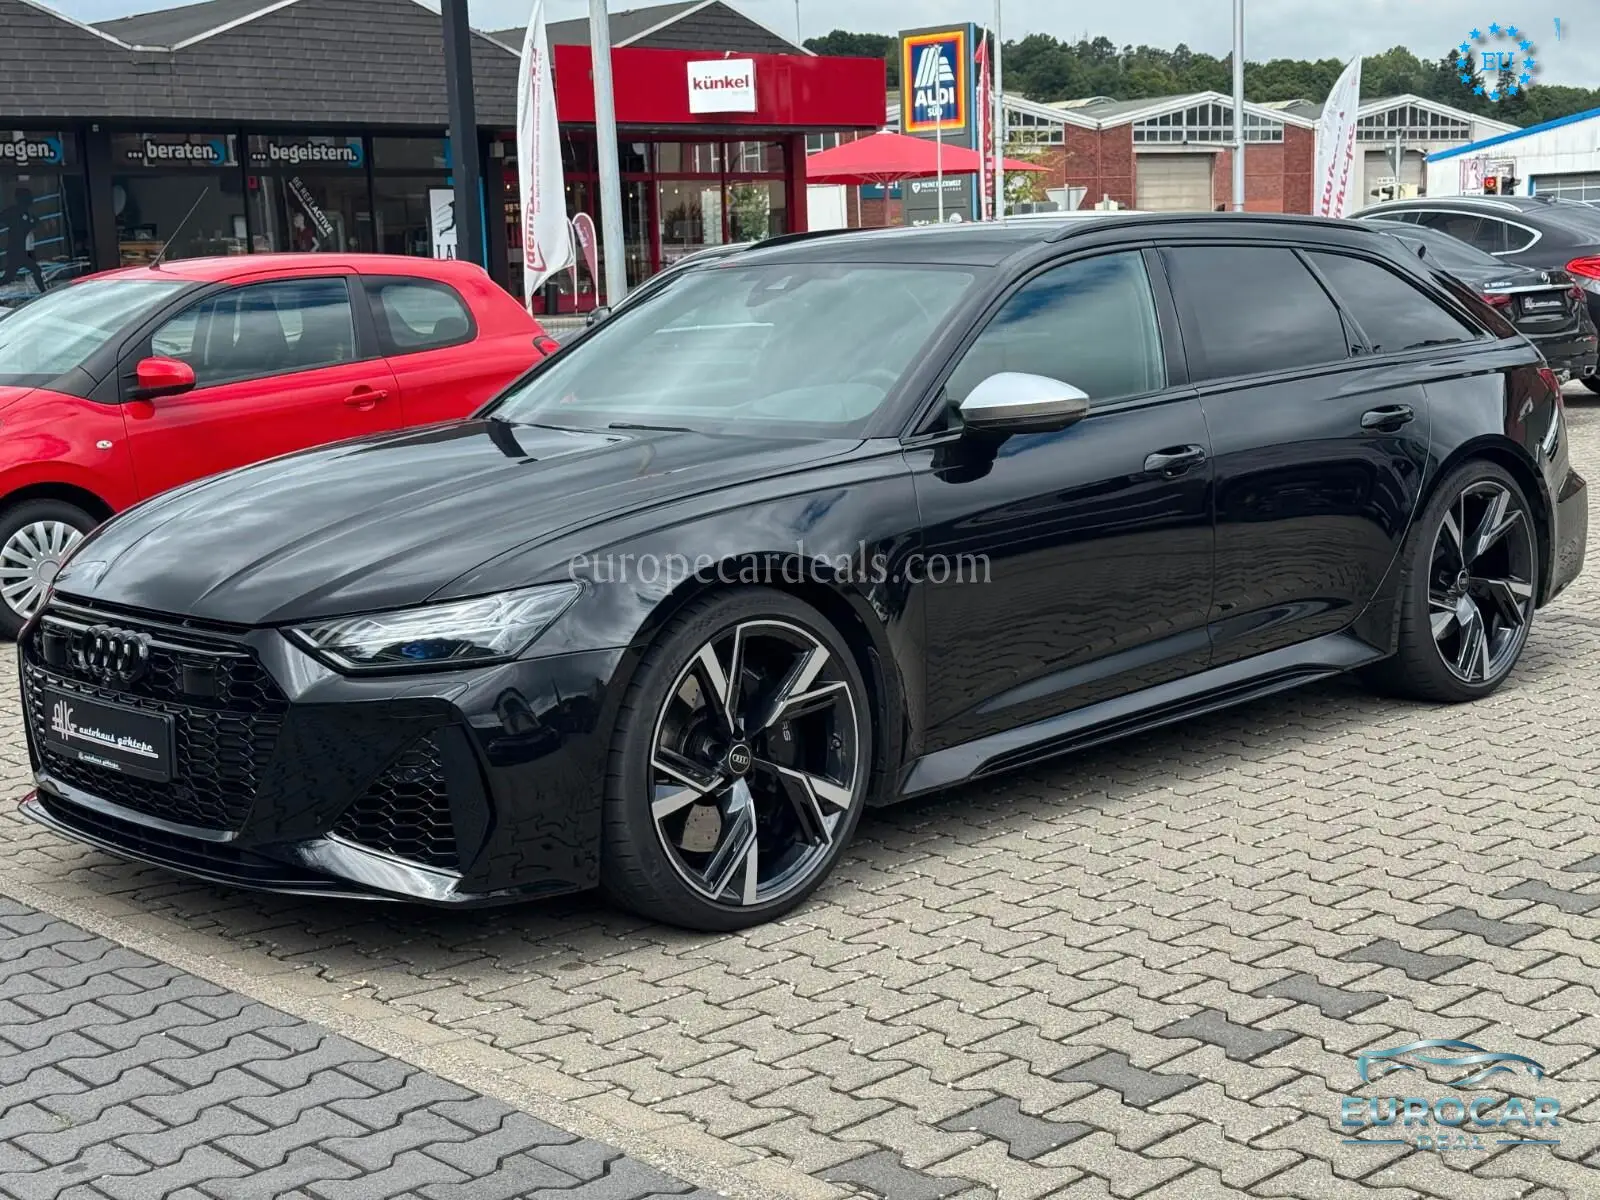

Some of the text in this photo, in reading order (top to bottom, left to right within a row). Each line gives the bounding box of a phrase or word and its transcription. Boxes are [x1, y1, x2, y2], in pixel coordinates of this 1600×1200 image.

[693, 74, 749, 90] künkel
[914, 87, 954, 107] ALDI
[147, 141, 218, 159] beraten.
[270, 143, 358, 163] begeistern.
[79, 726, 153, 752] autohaus göktepe
